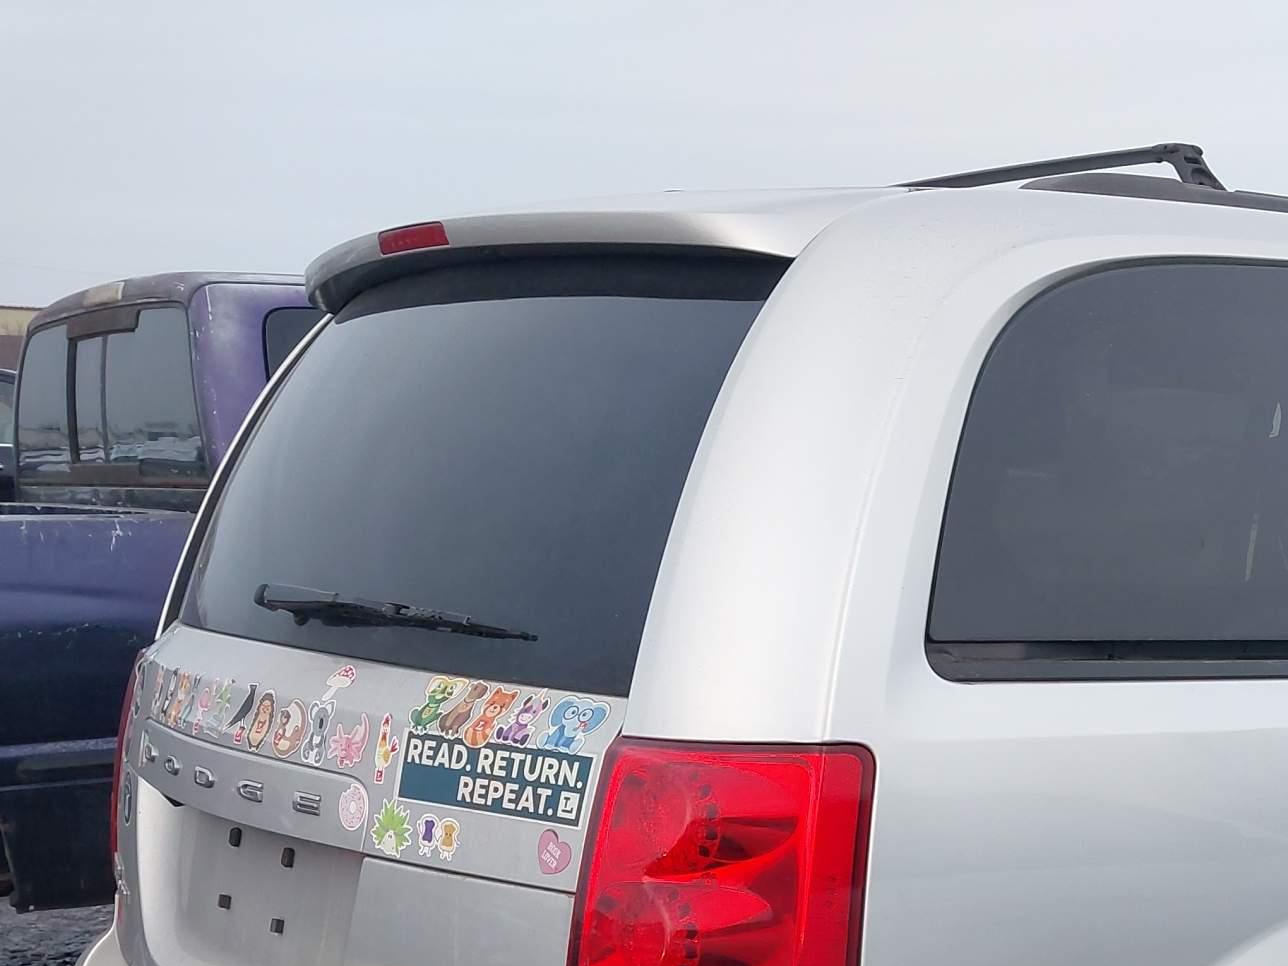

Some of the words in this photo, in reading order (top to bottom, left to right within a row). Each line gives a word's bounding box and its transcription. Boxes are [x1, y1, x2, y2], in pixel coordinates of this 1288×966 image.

[144, 743, 321, 817] DODGE
[406, 737, 472, 772] READ.
[476, 747, 583, 789] RETURN.
[456, 775, 553, 816] REPEAT.
